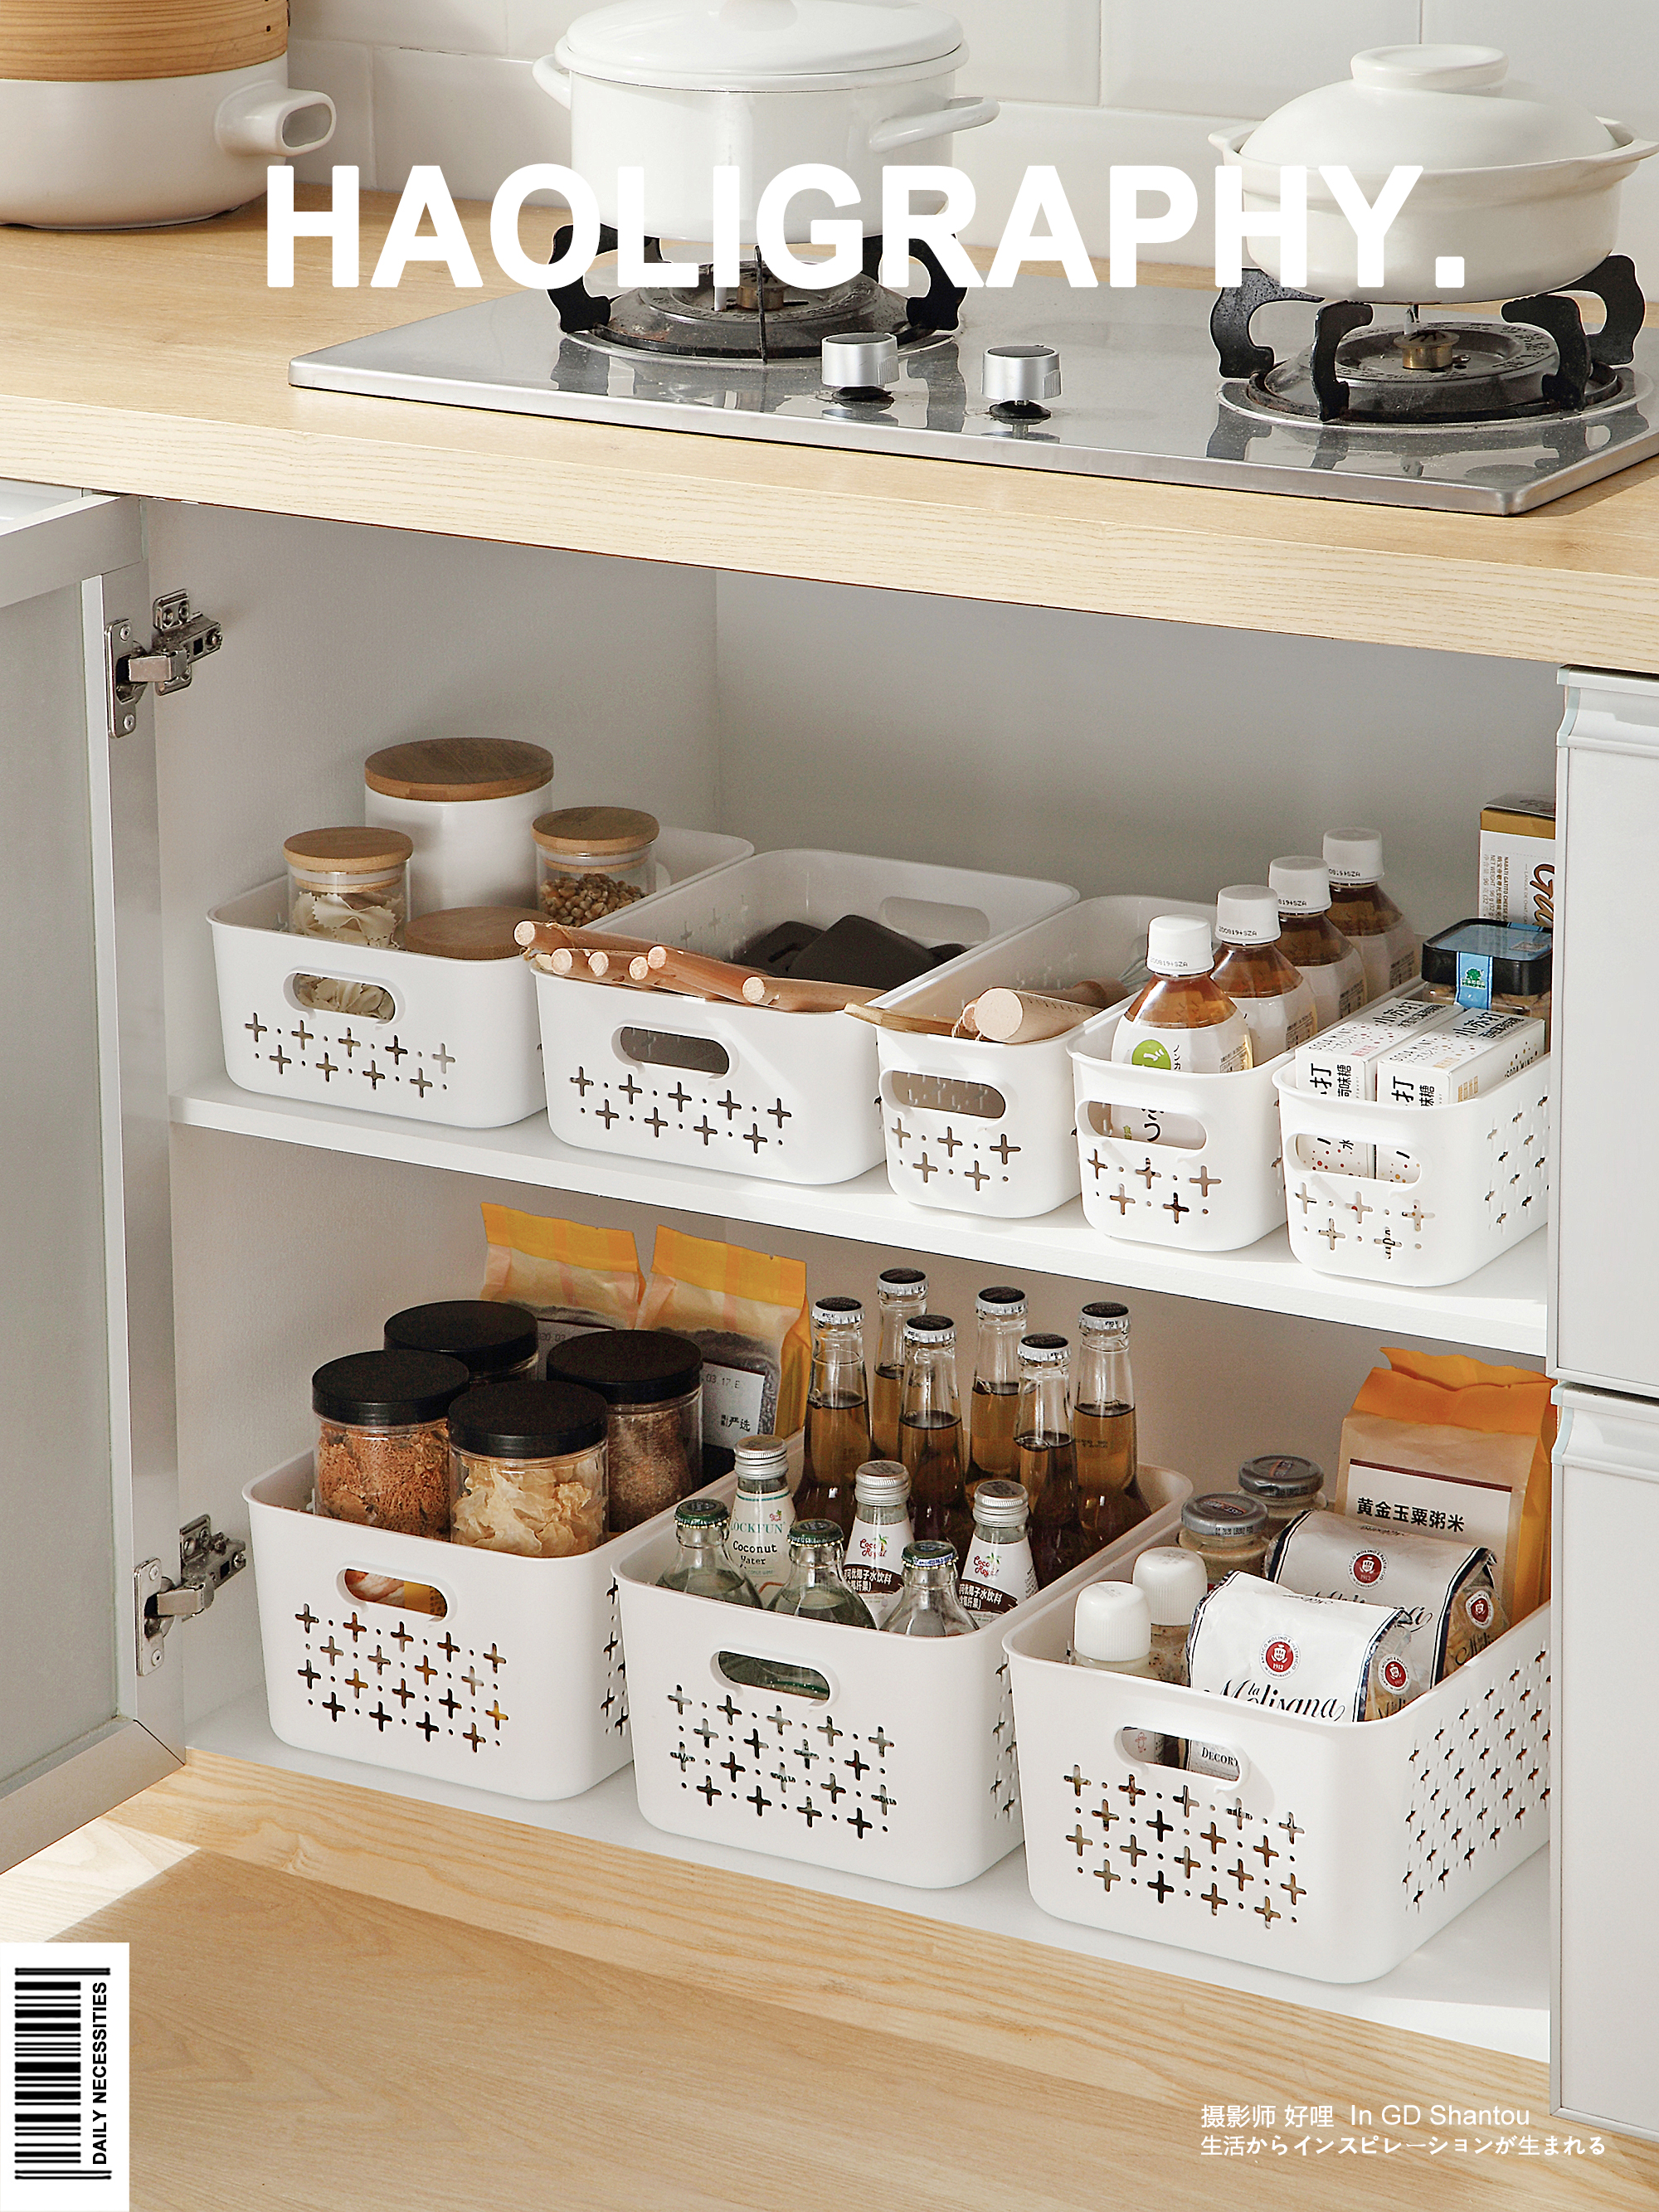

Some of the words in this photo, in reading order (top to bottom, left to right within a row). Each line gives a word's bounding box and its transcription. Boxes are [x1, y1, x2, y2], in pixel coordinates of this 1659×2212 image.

[1453, 1012, 1505, 1036] 小苏打
[1310, 1063, 1332, 1095] 打
[1357, 1497, 1464, 1533] 黄金玉粟粥米
[732, 1540, 777, 1553] Coconut
[974, 1556, 990, 1568] Coco
[1248, 1682, 1260, 1696] la
